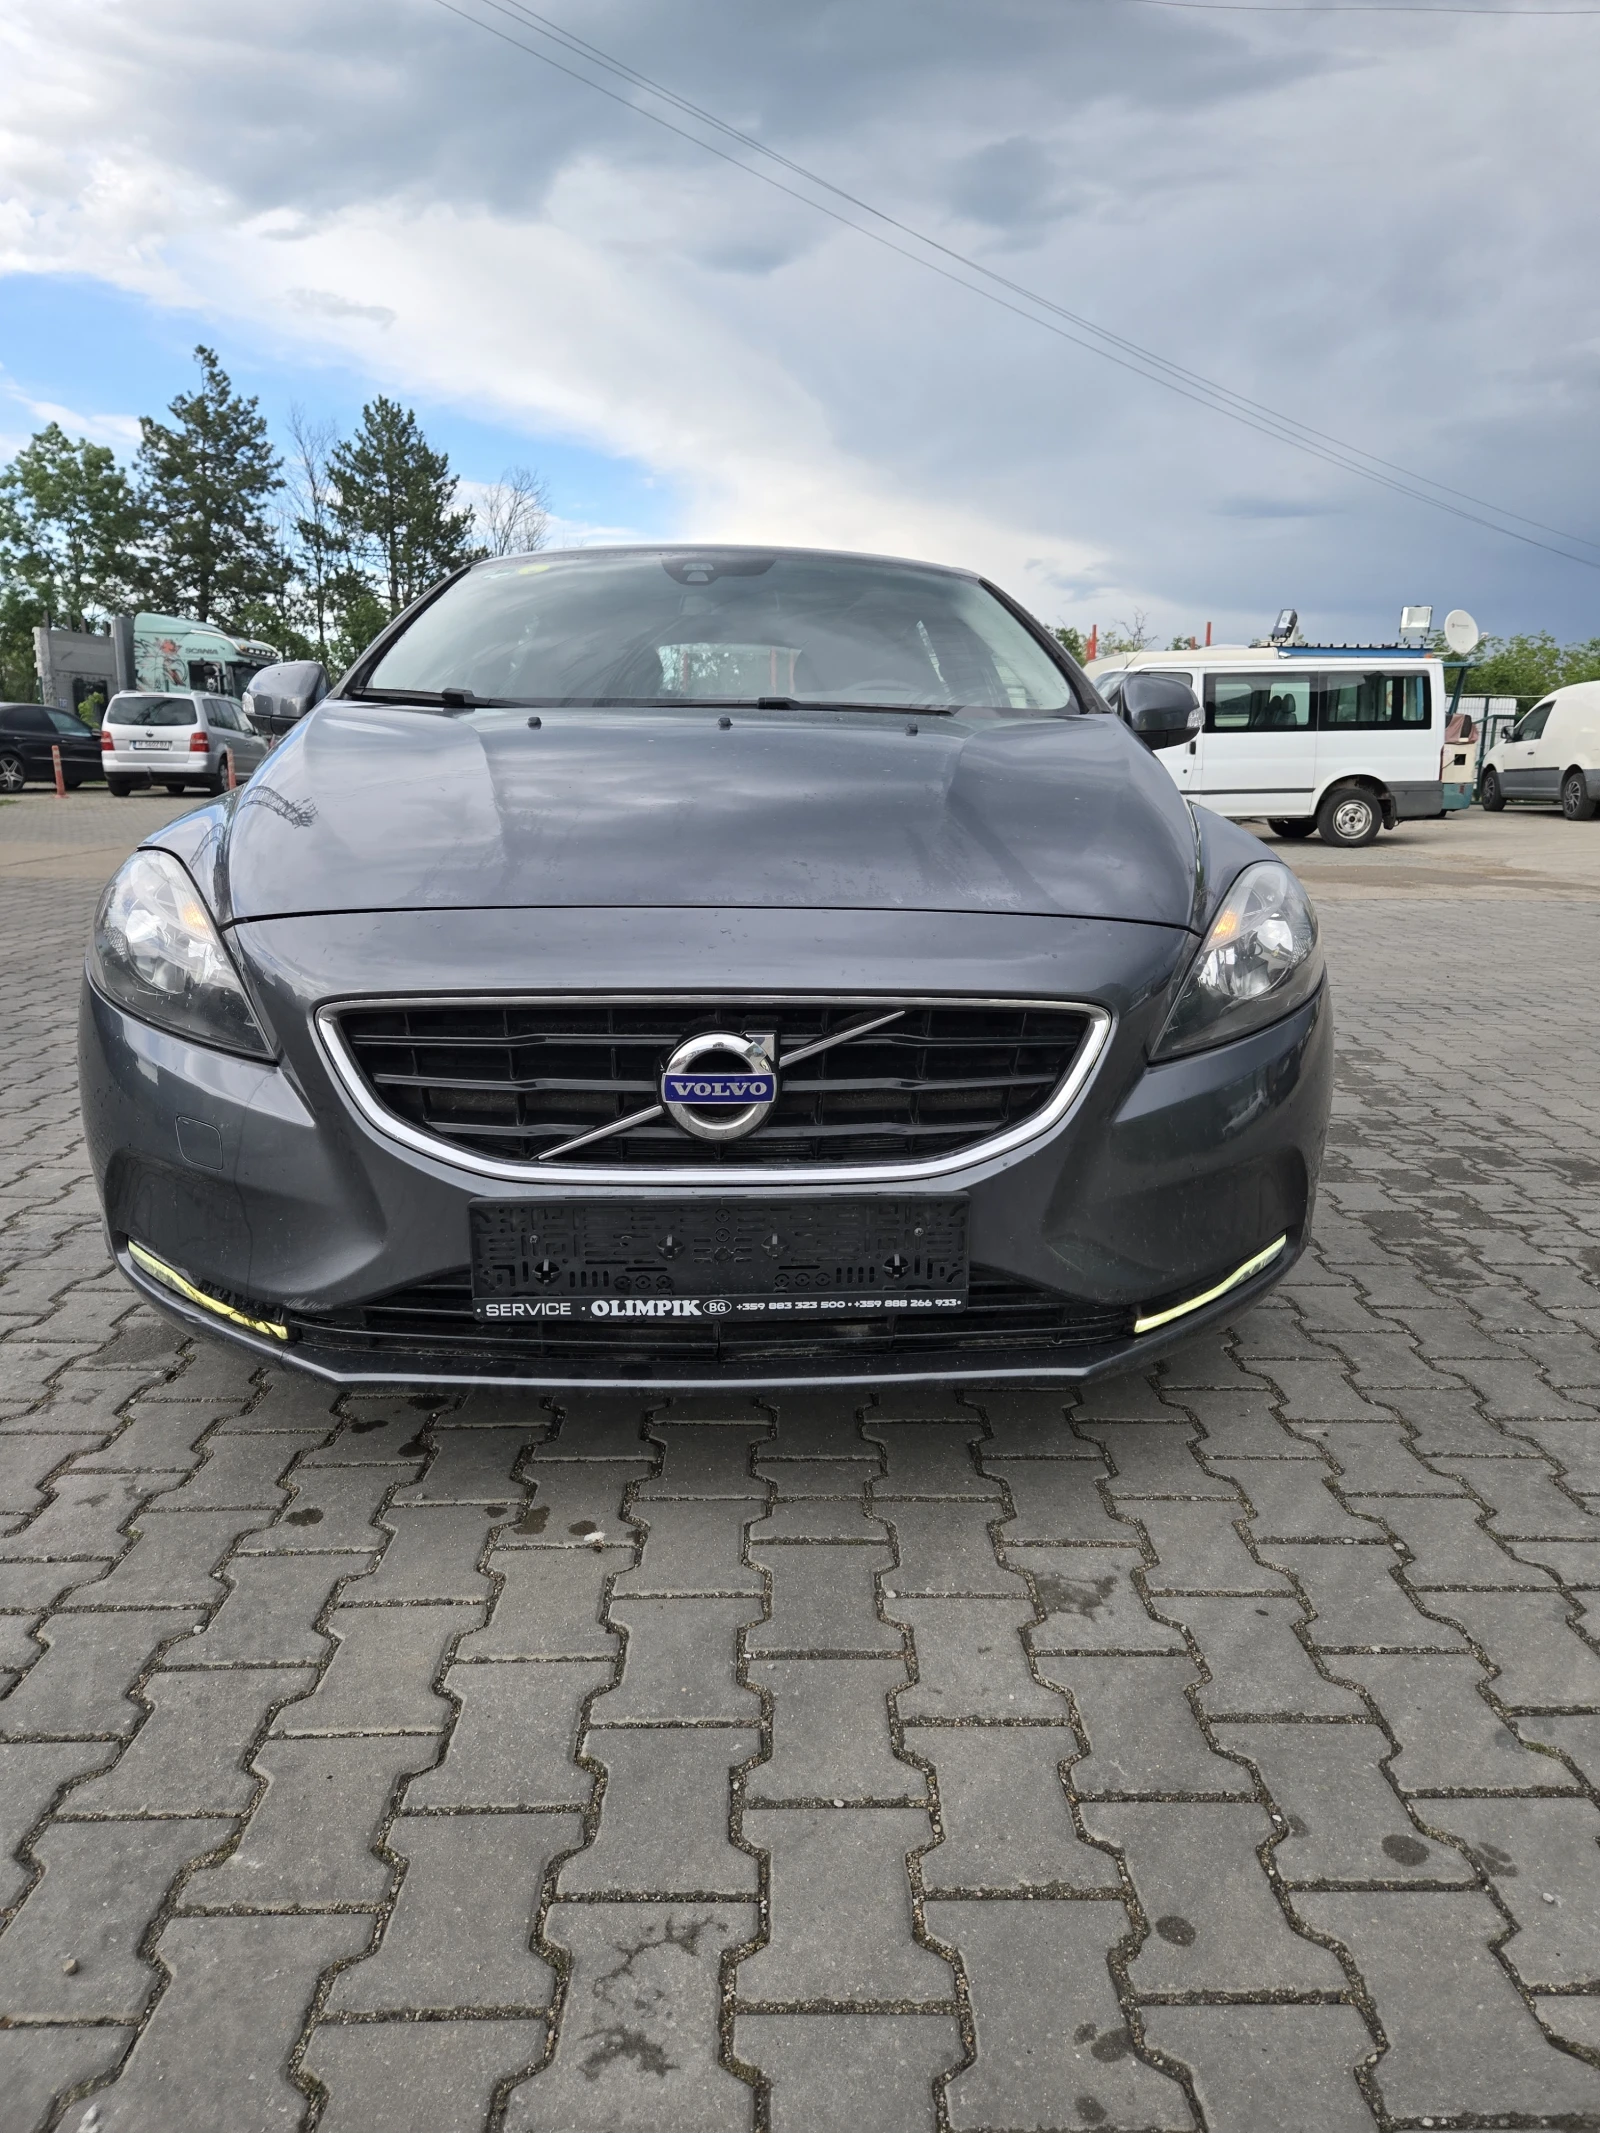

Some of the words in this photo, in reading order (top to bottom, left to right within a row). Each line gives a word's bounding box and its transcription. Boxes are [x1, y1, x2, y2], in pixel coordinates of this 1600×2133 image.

[185, 647, 219, 655] SCANIA
[670, 1082, 768, 1096] VOLVO
[485, 1303, 572, 1317] SERVICE
[591, 1300, 702, 1317] OLIMPIK
[708, 1303, 726, 1313] BG
[736, 1303, 765, 1311] +359
[768, 1302, 792, 1310] 883
[795, 1301, 818, 1309] 323
[820, 1301, 846, 1309] 500
[854, 1300, 882, 1308] +359
[884, 1300, 908, 1308] 888
[910, 1299, 933, 1307] 266
[935, 1299, 957, 1307] 933
